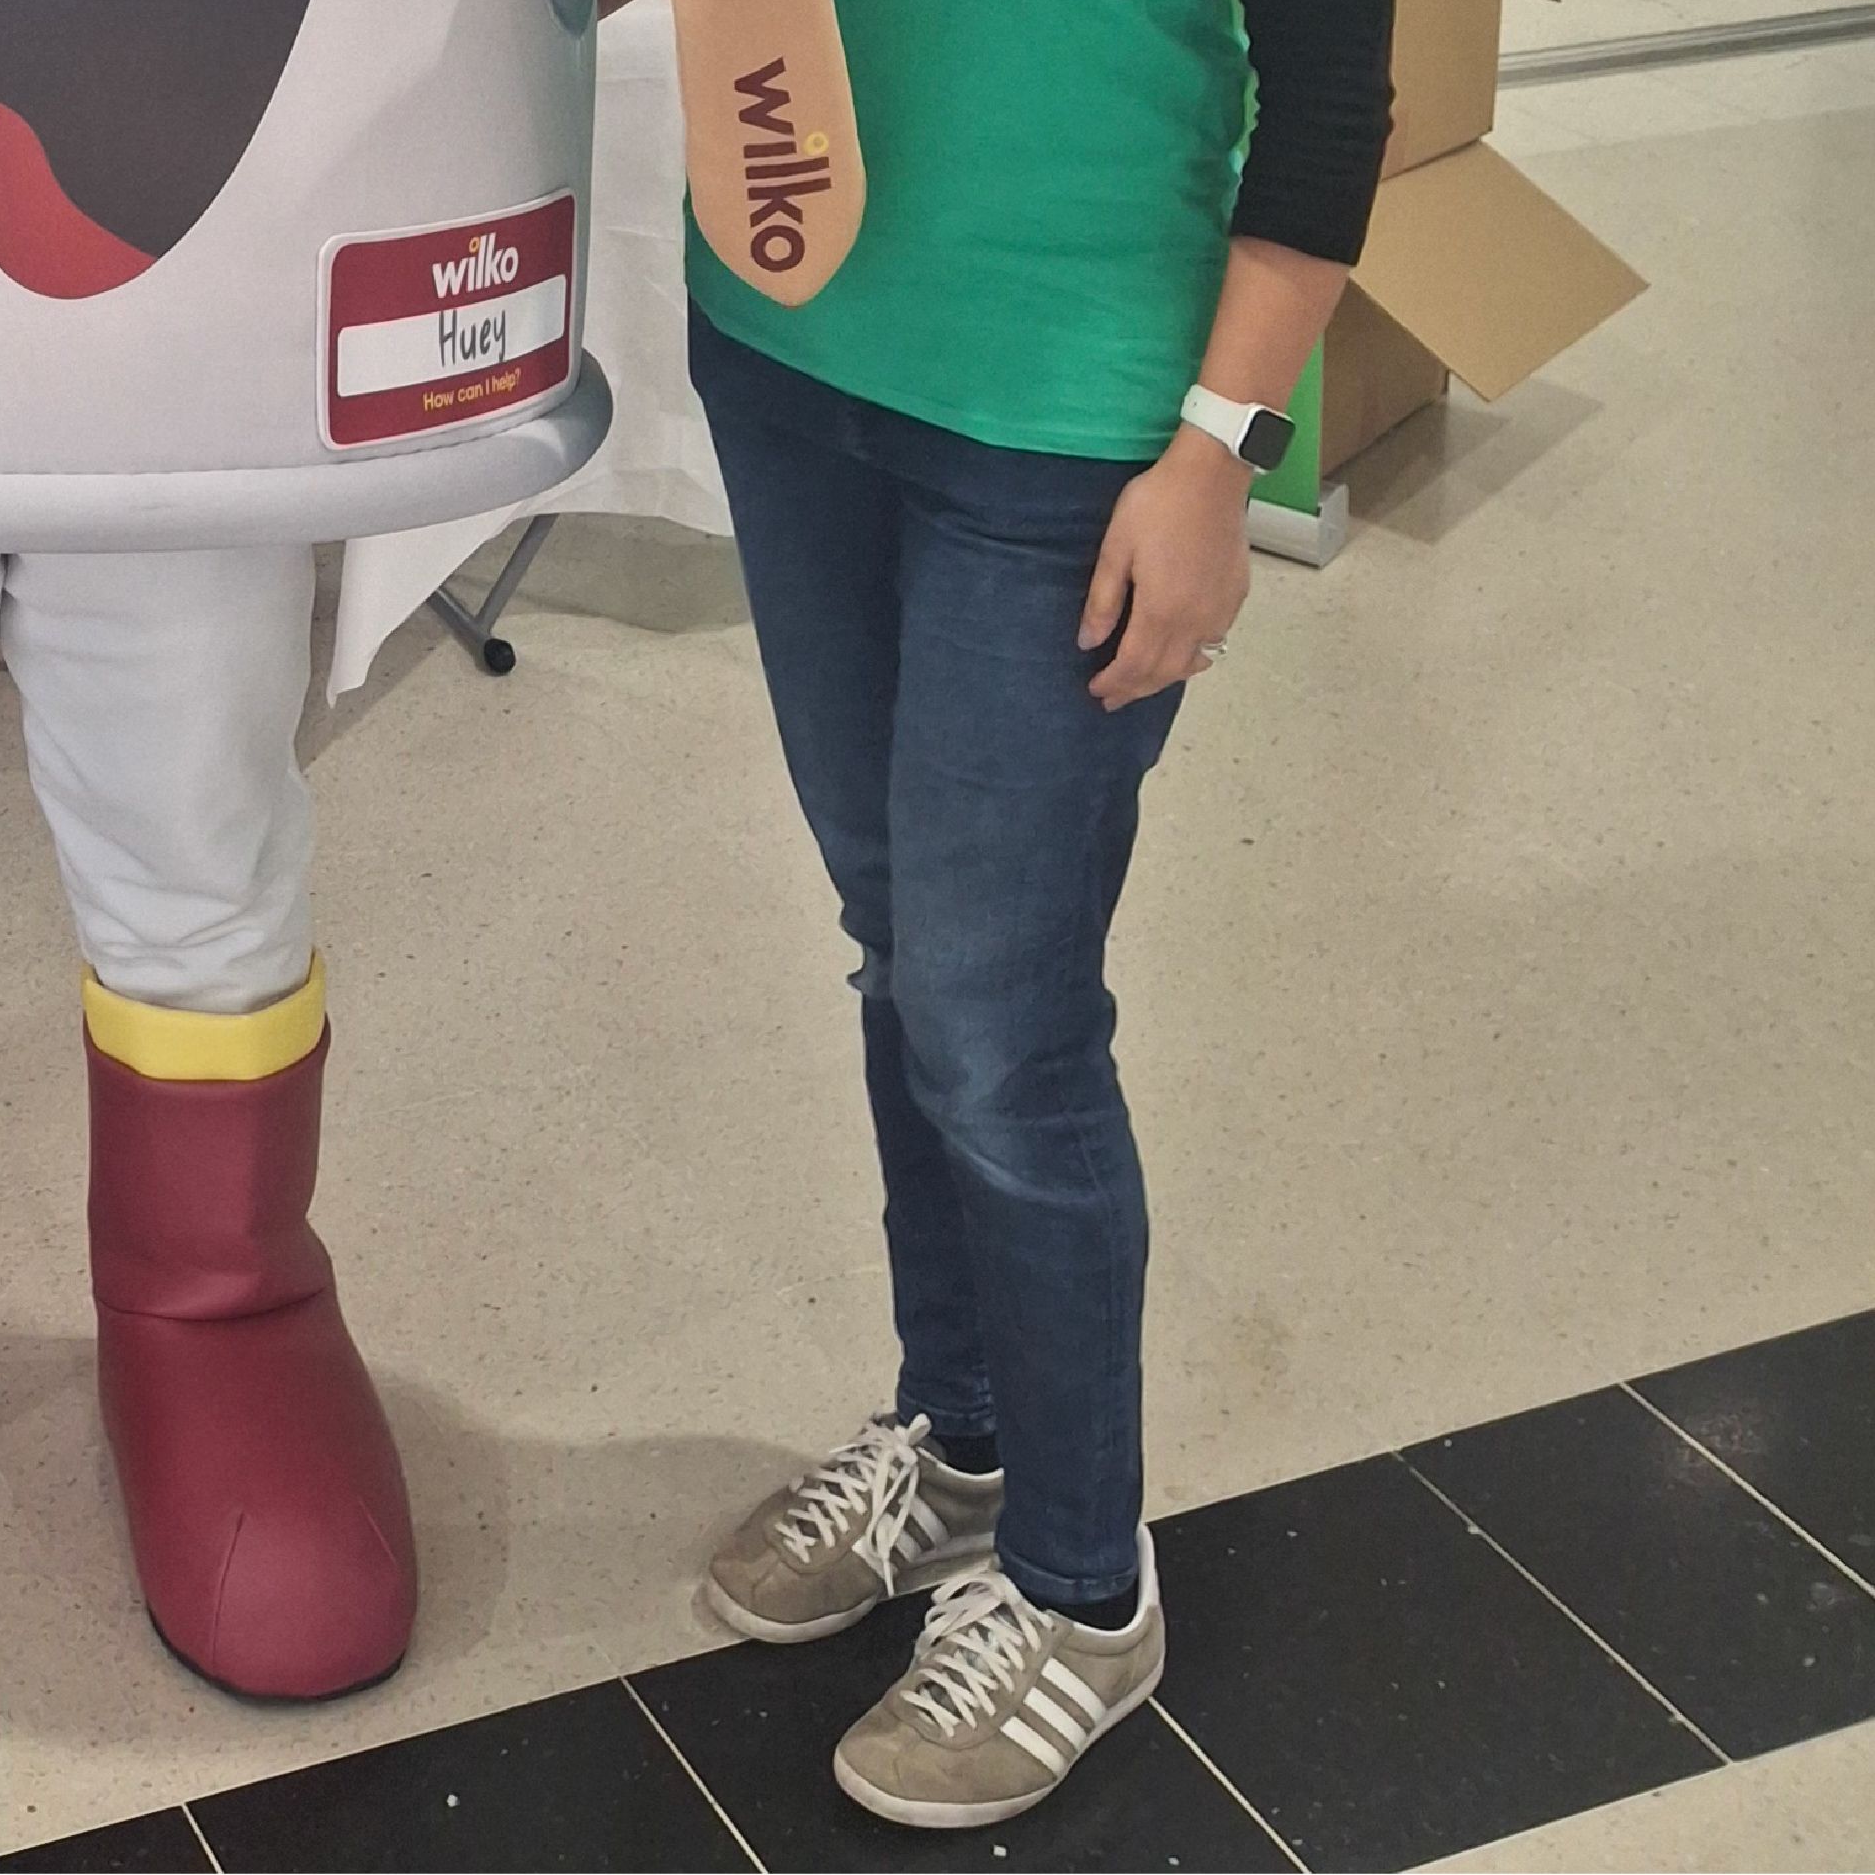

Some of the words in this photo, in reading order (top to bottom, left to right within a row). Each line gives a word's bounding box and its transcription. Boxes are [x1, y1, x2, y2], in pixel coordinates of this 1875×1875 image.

[734, 56, 831, 273] wilko
[432, 232, 519, 299] wilko
[438, 309, 507, 367] Huey
[423, 390, 455, 412] How
[458, 383, 484, 402] can
[491, 367, 522, 393] help?
